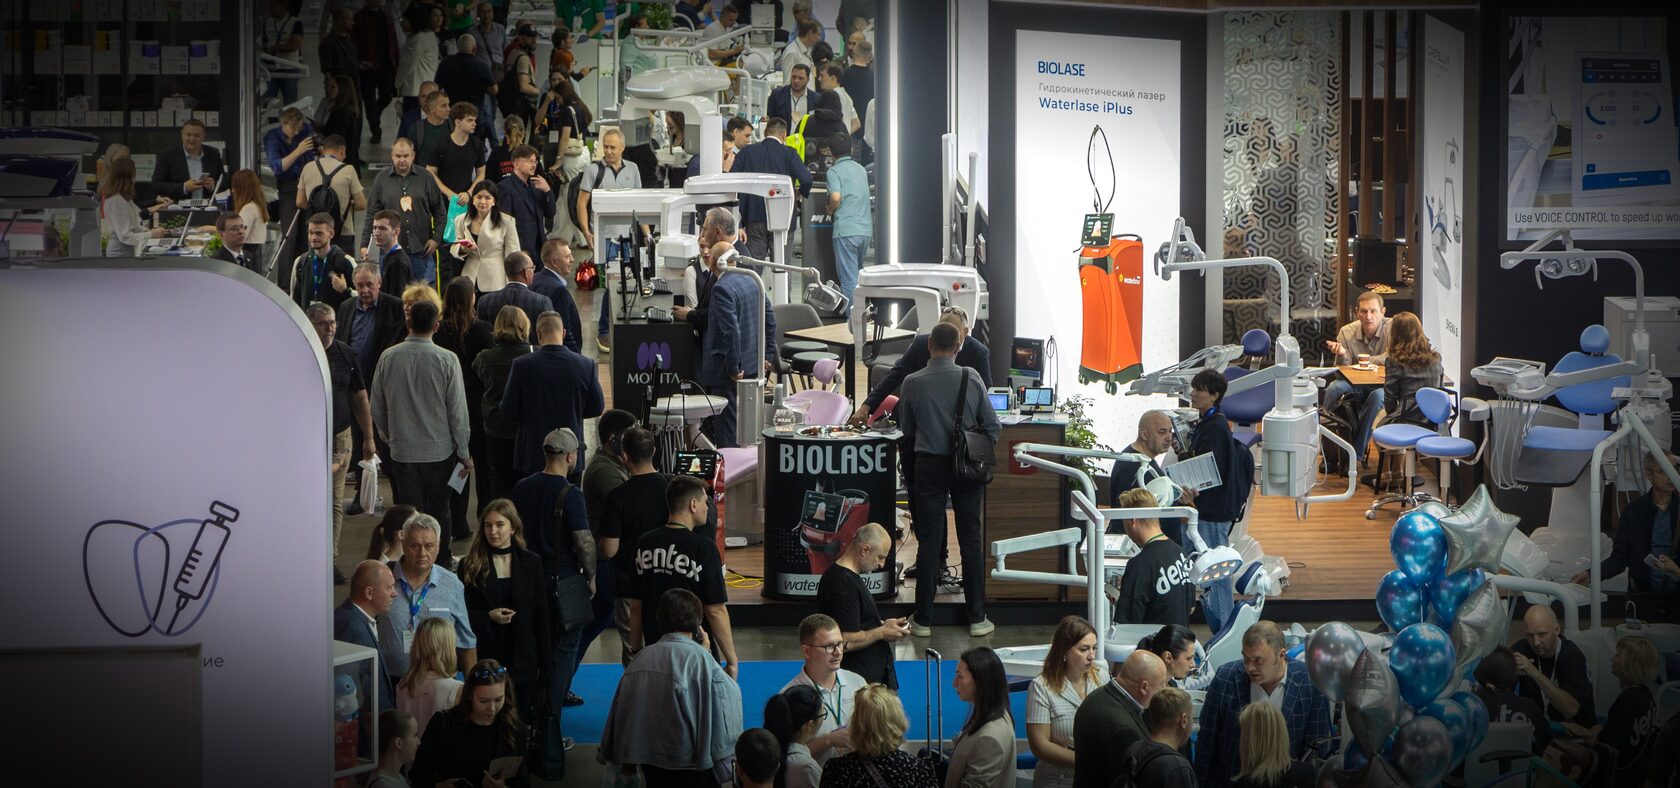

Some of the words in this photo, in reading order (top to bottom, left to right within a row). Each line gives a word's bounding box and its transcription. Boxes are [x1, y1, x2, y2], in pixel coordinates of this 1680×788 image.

[1038, 61, 1085, 77] BIOLASE
[1039, 83, 1135, 98] Гидрокинетический
[1137, 92, 1166, 102] лазер
[1039, 97, 1100, 112] Waterlase
[1103, 101, 1133, 115] iPlus
[1515, 213, 1532, 223] Use
[1535, 213, 1562, 223] VOICE
[1565, 212, 1608, 223] CONTROL
[1611, 213, 1620, 222] to
[1622, 212, 1649, 224] speed
[1652, 213, 1663, 223] up
[627, 372, 681, 385] MOITA
[780, 443, 888, 475] BIOLASE
[635, 544, 703, 582] dentex
